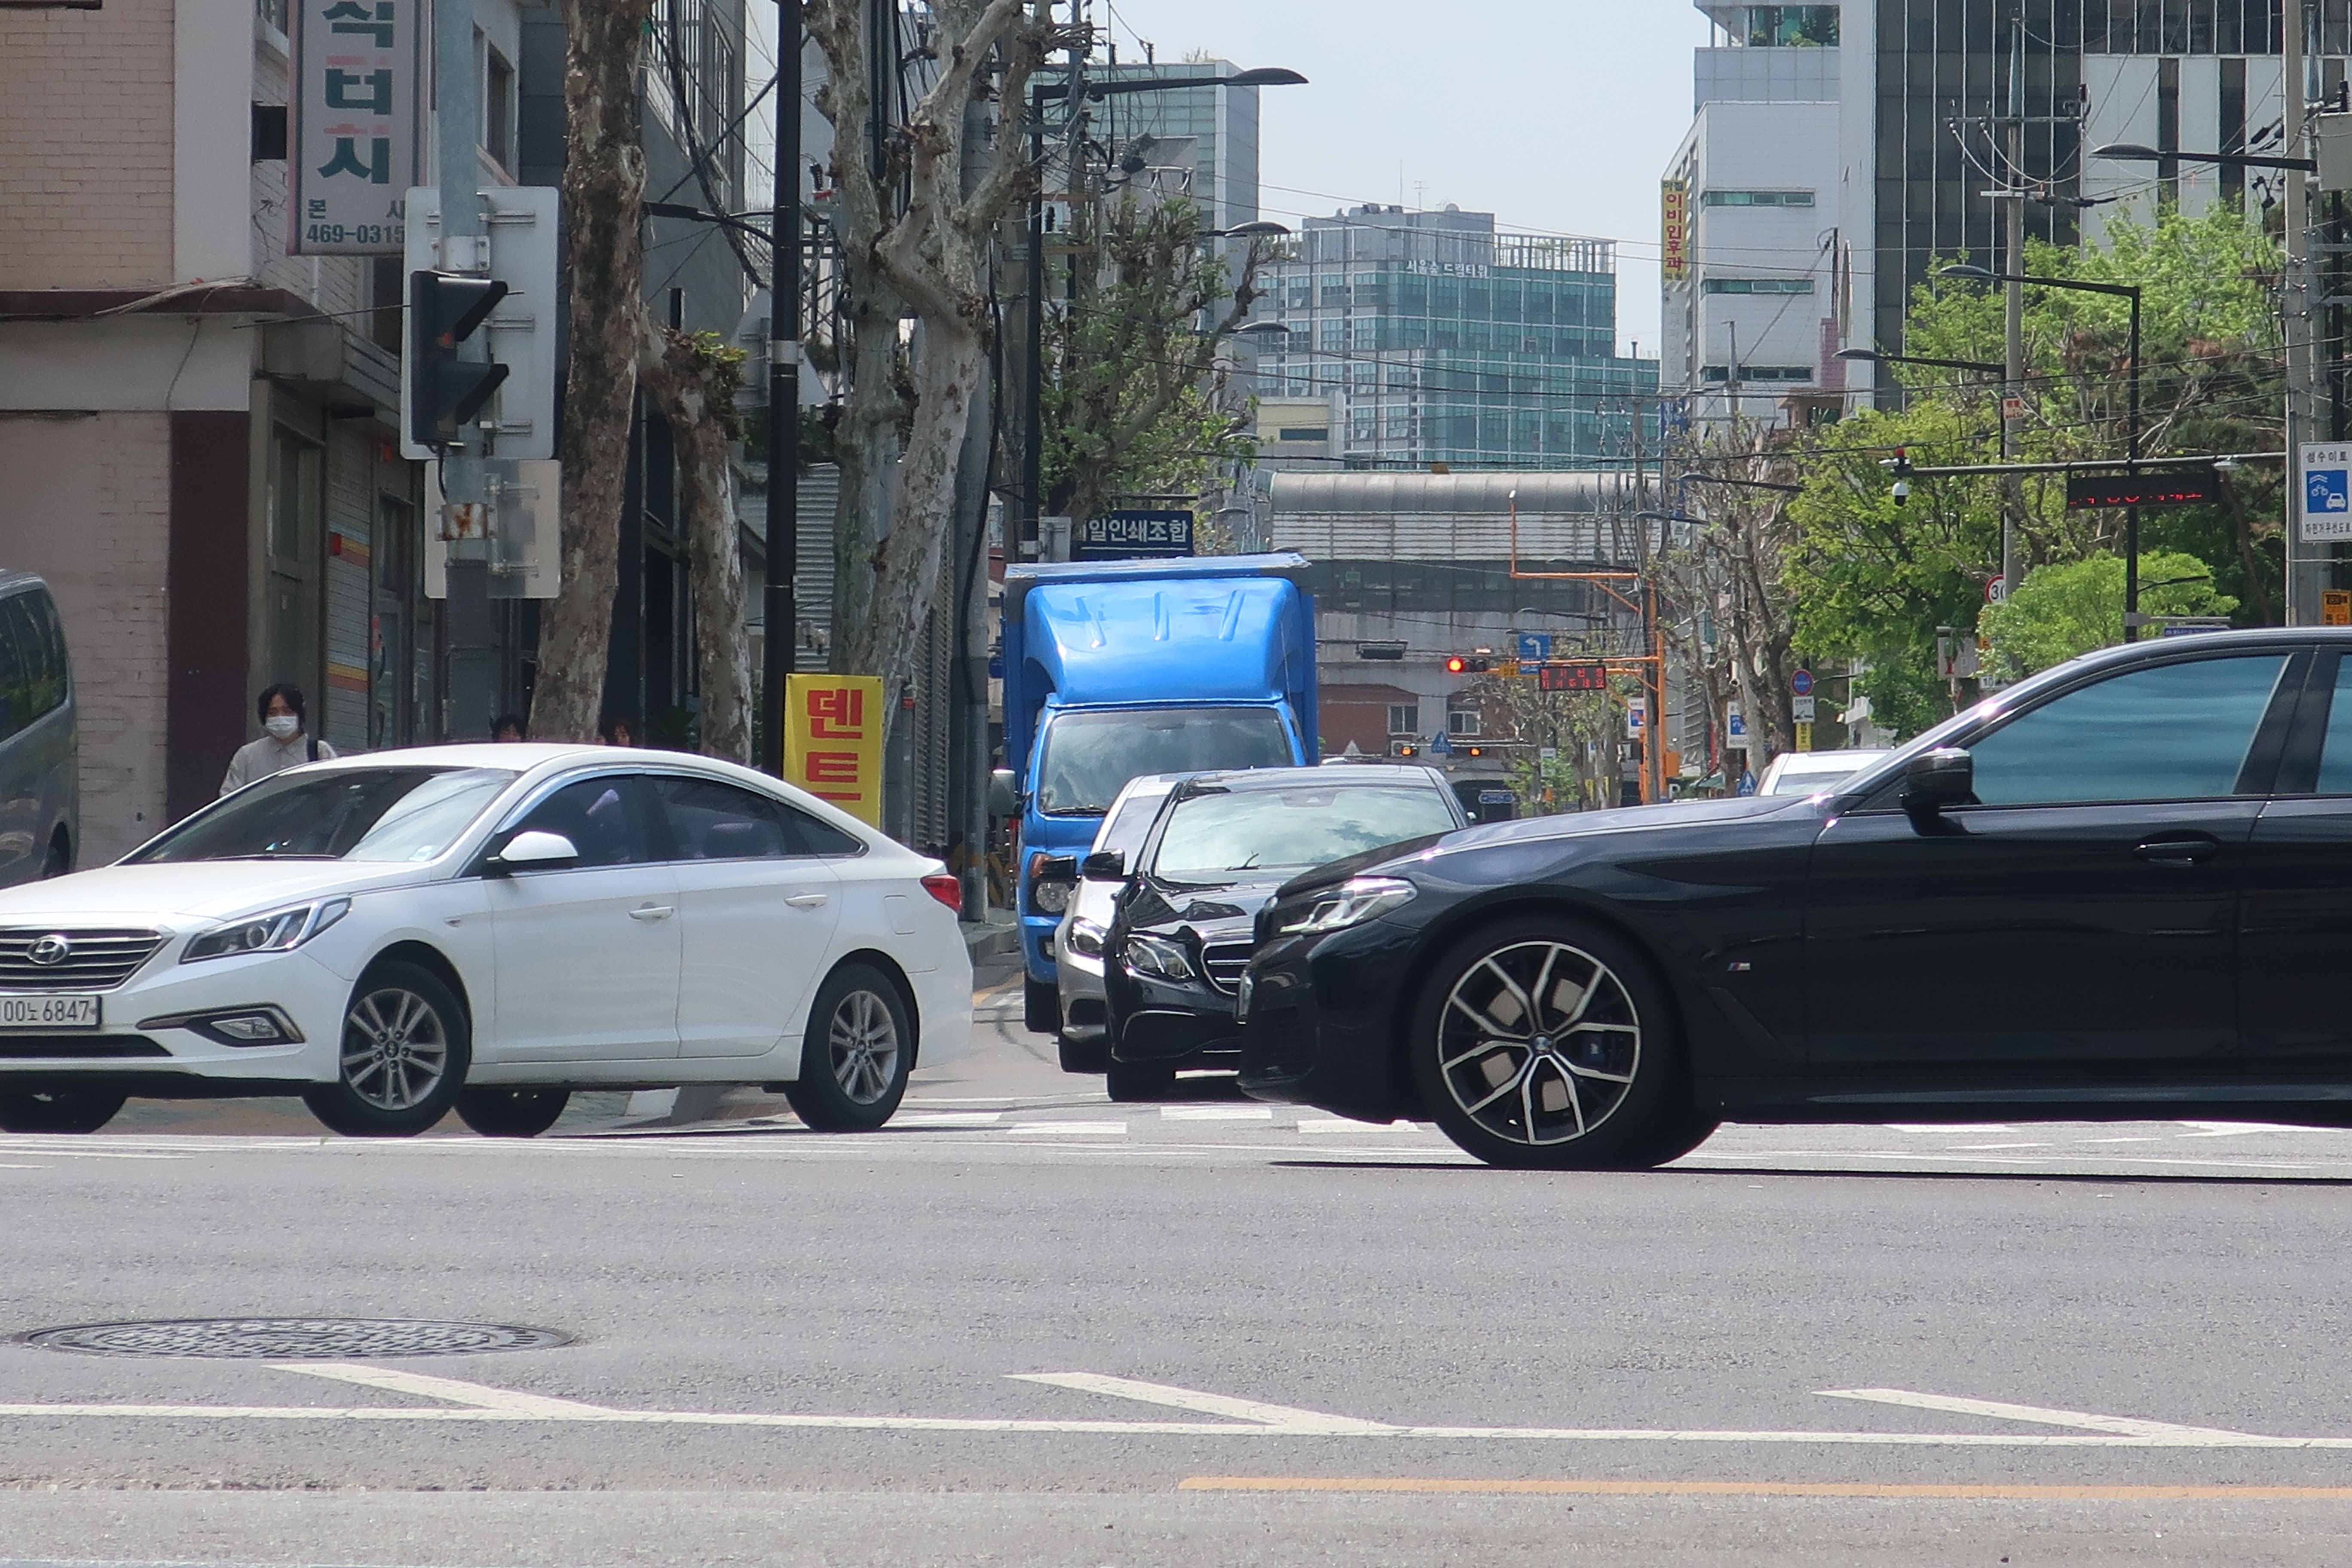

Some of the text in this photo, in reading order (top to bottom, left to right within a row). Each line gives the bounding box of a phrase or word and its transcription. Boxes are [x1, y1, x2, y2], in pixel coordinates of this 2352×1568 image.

[306, 224, 405, 244] 469-0315
[1666, 193, 1682, 271] 이비인후과
[1079, 518, 1188, 542] 일인쇄조합
[805, 689, 863, 801] 덴트
[43, 1000, 89, 1021] 6847
